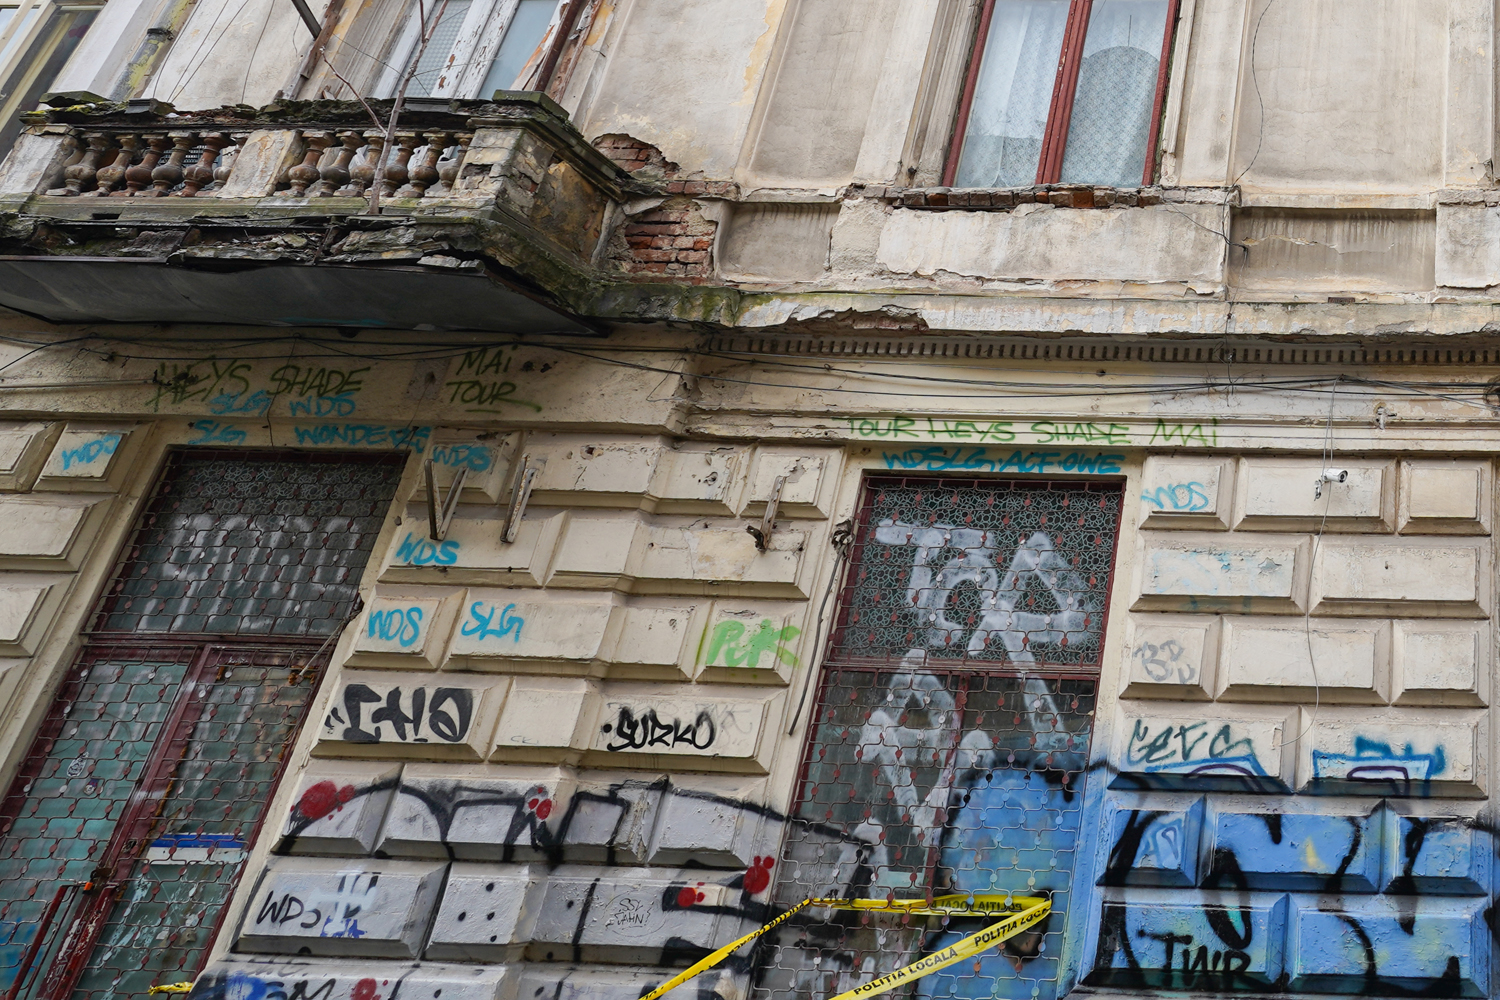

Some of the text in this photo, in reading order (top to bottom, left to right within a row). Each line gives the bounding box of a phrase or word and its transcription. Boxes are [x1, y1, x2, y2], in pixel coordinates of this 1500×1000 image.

[267, 365, 371, 396] SHADE
[446, 380, 541, 411] TOUR
[847, 415, 919, 439] TOUR
[926, 417, 1016, 443] HEYS
[1031, 420, 1130, 445] SHADE
[395, 532, 460, 566] WDS
[367, 606, 424, 647] WDS
[461, 600, 525, 643] SLG
